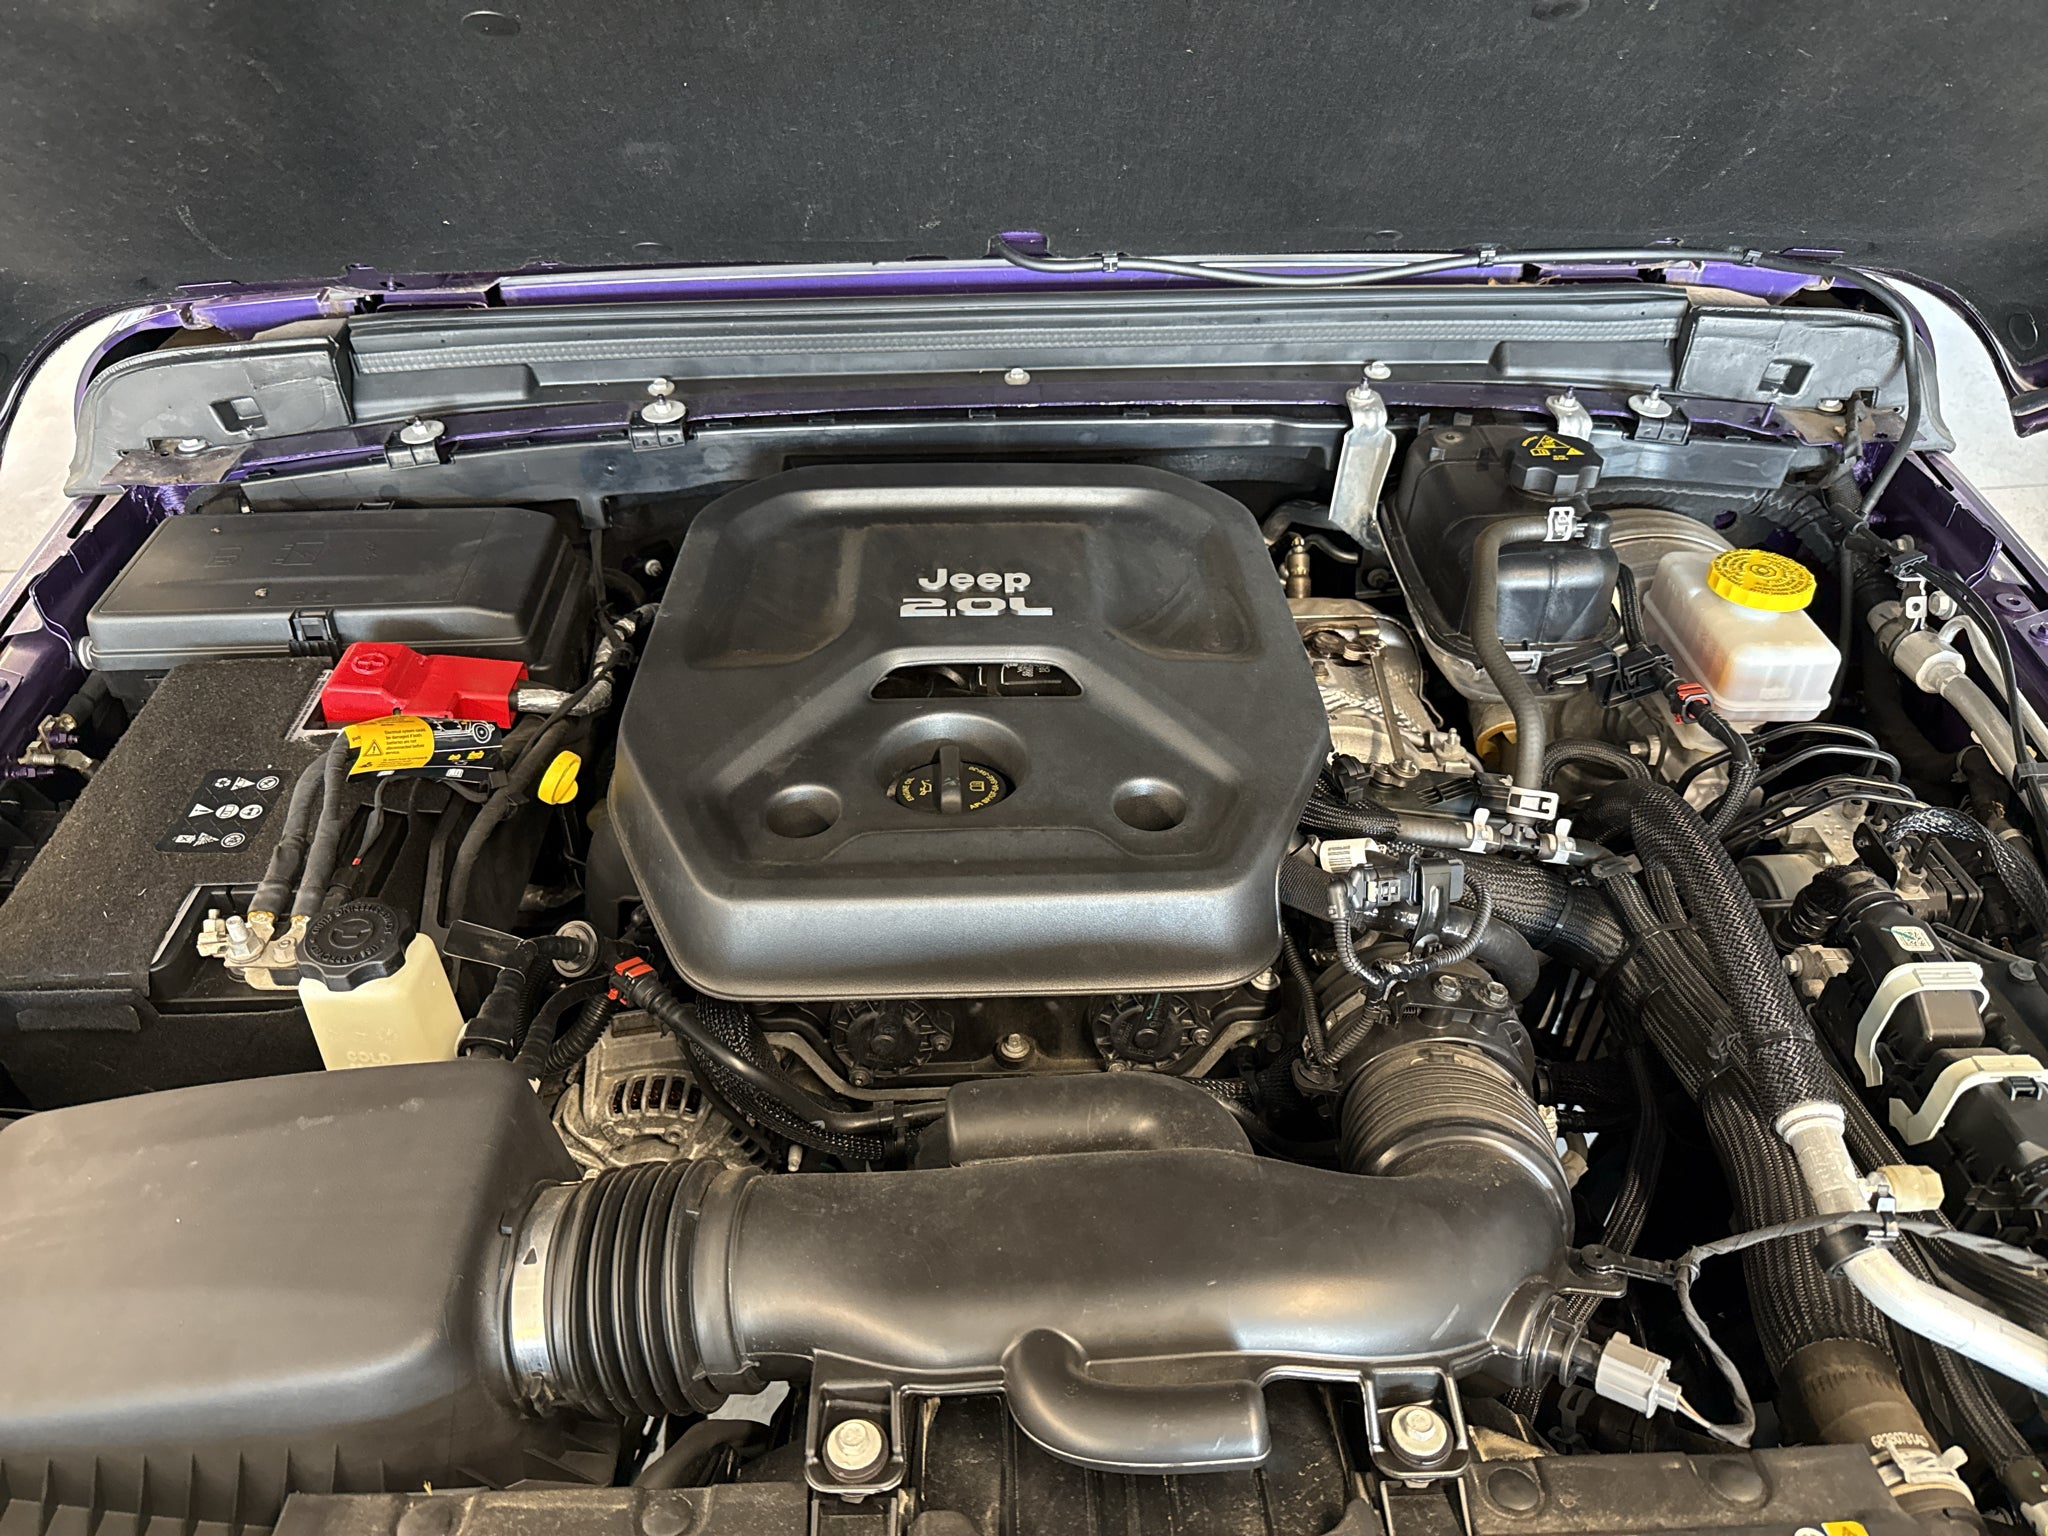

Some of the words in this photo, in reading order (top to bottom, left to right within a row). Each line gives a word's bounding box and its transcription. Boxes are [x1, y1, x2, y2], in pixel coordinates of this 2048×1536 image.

[918, 568, 1031, 593] Jeep
[900, 597, 1053, 617] 2.0L
[904, 777, 915, 785] OIL
[902, 785, 915, 801] ENGINE
[346, 1050, 392, 1064] COLD
